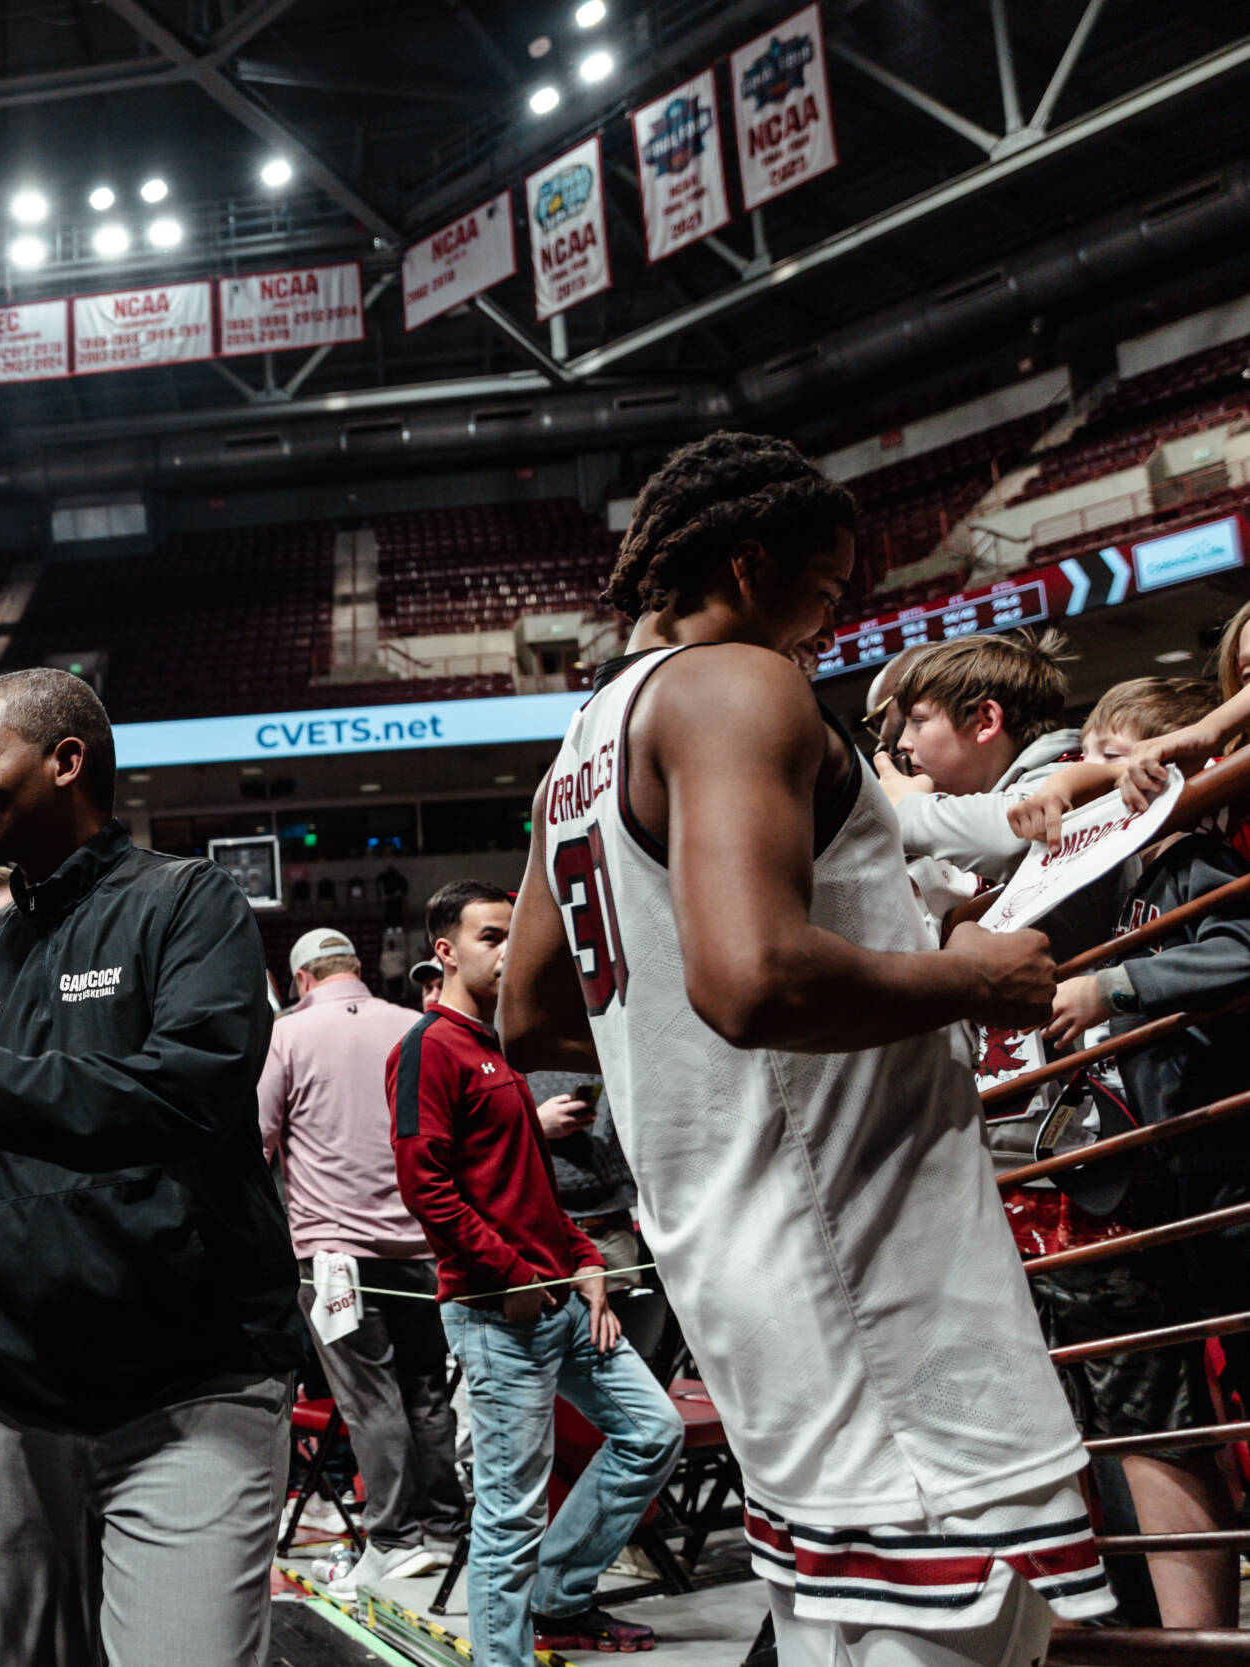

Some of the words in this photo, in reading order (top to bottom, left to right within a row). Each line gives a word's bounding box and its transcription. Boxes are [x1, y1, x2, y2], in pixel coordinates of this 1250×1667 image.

[746, 94, 819, 159] NCAA
[431, 217, 479, 263] NCAA
[539, 221, 597, 273] NCAA
[114, 292, 170, 318] NCAA
[260, 274, 319, 300] NCAA
[256, 713, 444, 748] CVETS.net
